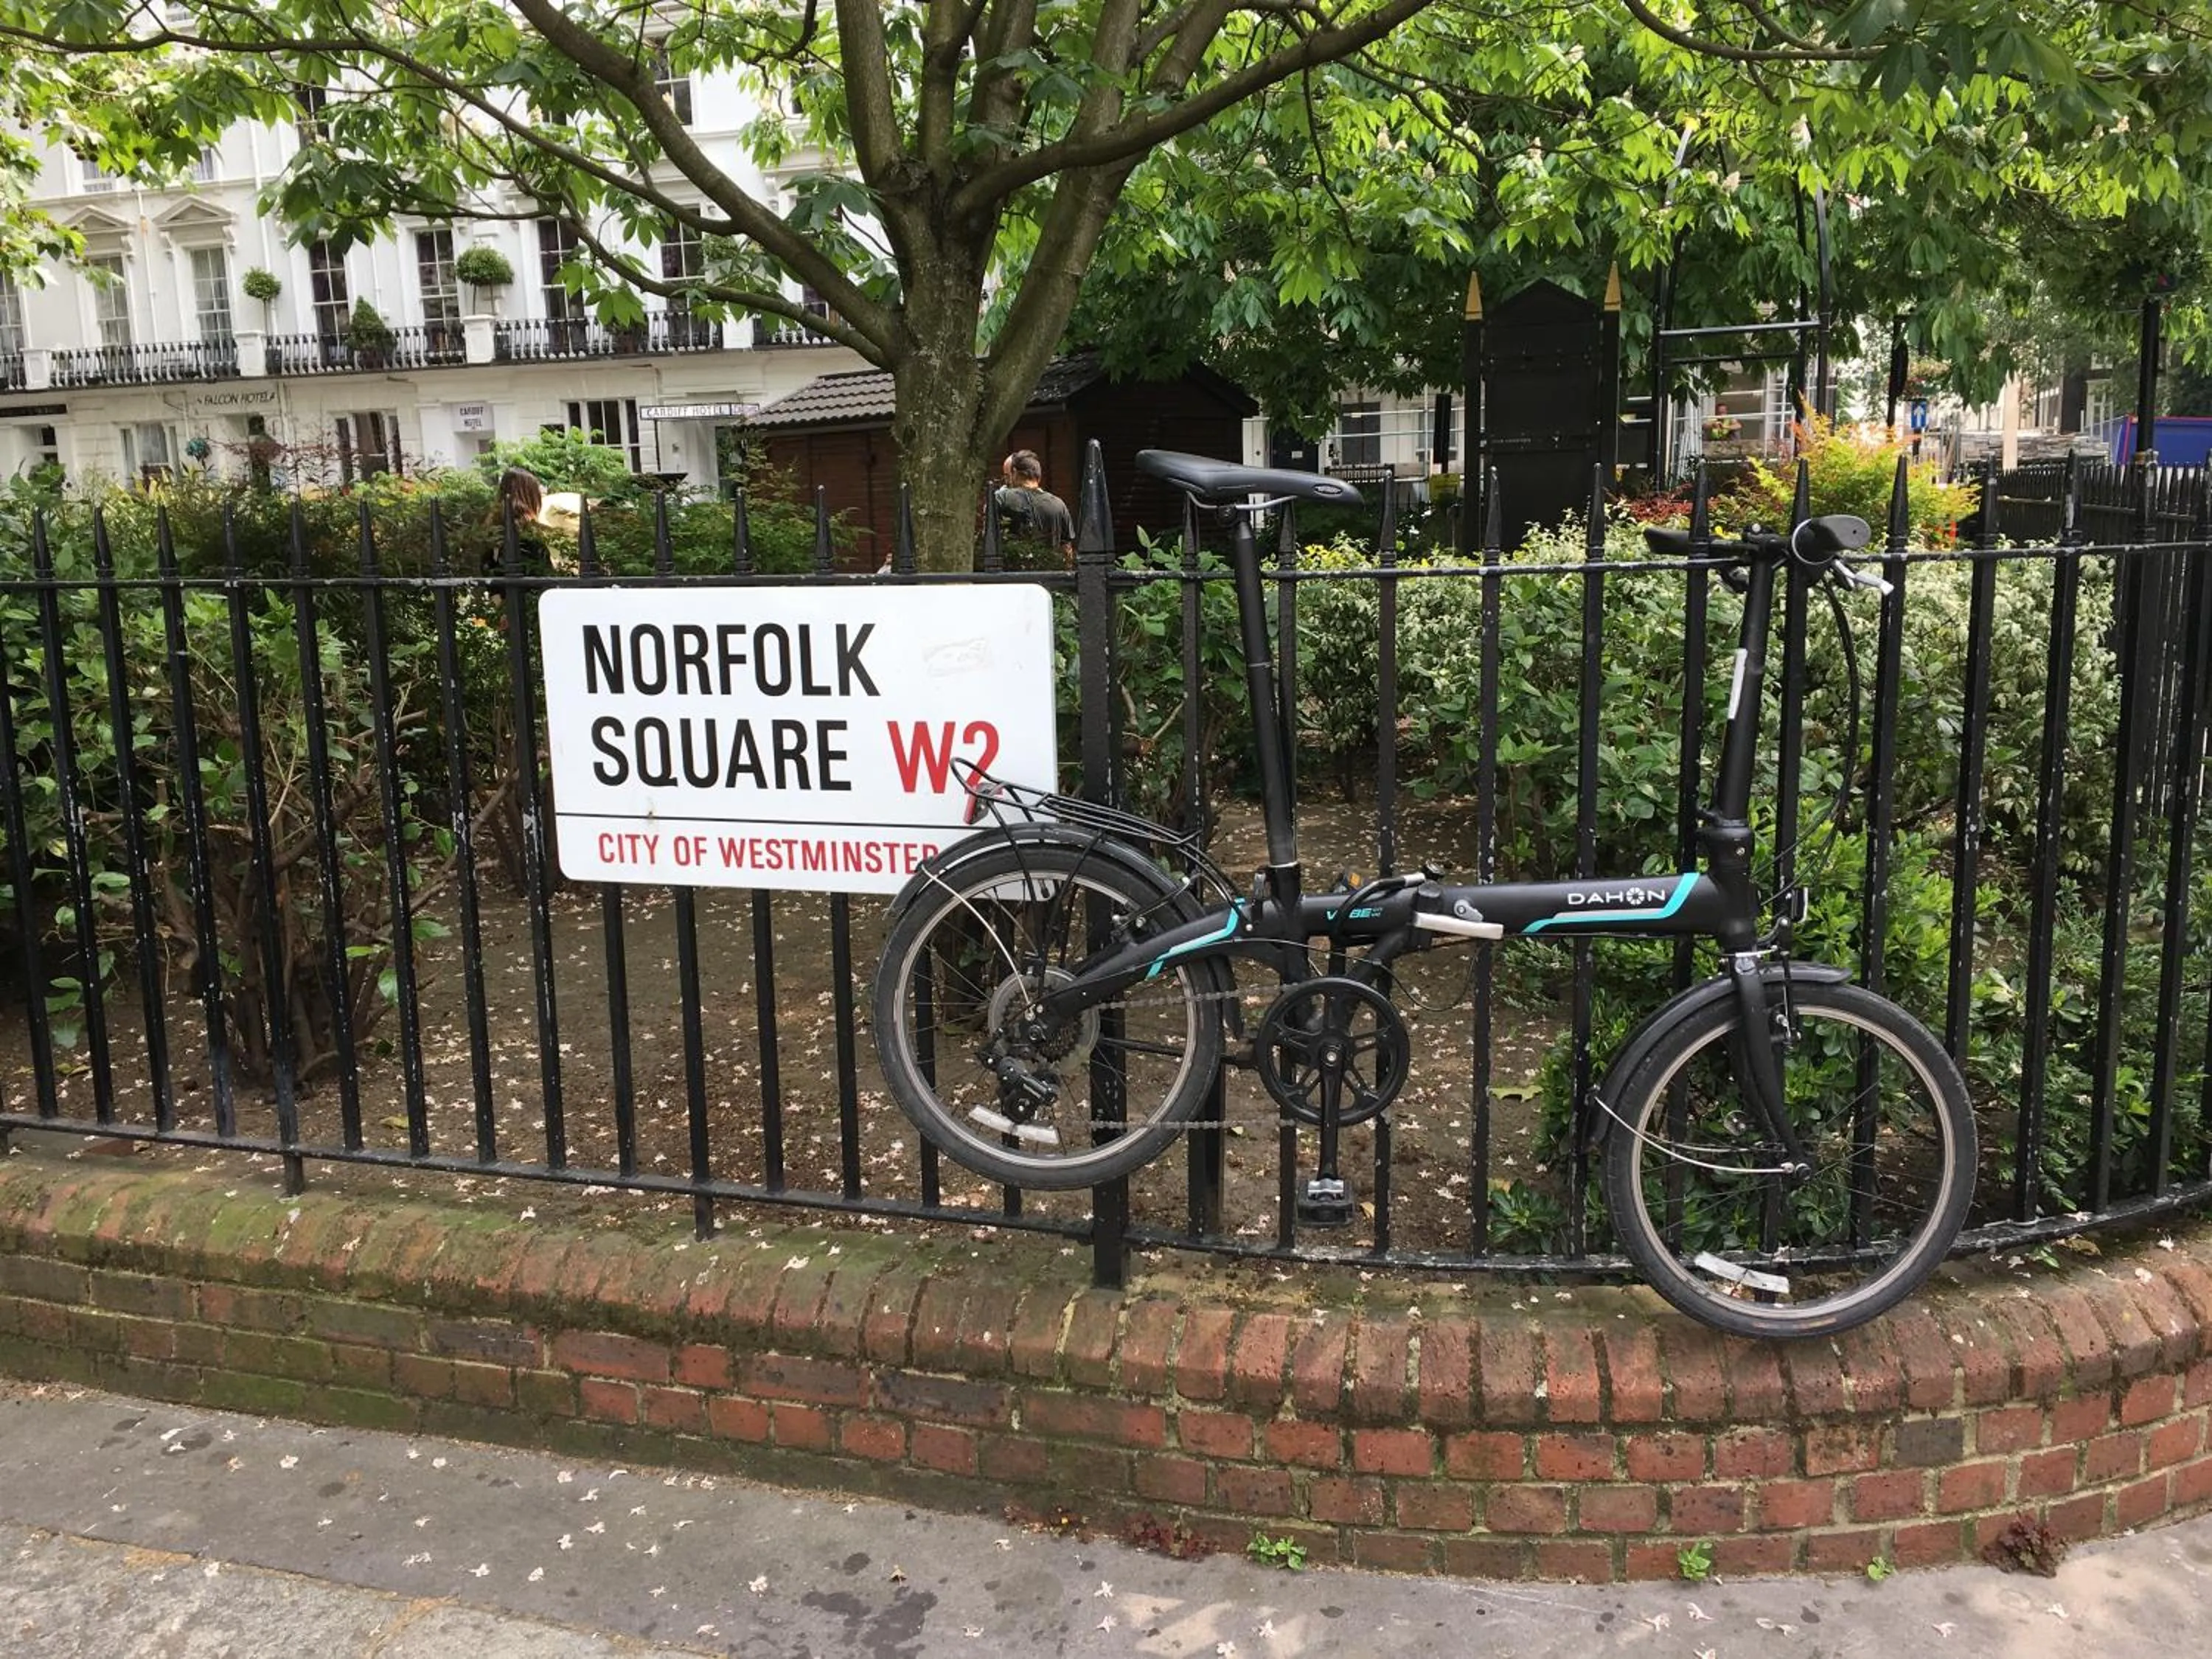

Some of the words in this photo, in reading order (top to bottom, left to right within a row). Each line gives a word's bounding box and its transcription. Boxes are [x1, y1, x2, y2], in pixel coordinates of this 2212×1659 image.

[204, 392, 237, 405] FALCON
[241, 391, 271, 403] HOTEL
[582, 623, 880, 697] NORFOLK
[591, 716, 852, 791] SQUARE
[887, 720, 1002, 795] W2
[598, 833, 658, 863] CITY
[673, 836, 706, 866] OF
[1567, 887, 1666, 905] DAHON
[1326, 908, 1371, 920] VBE
